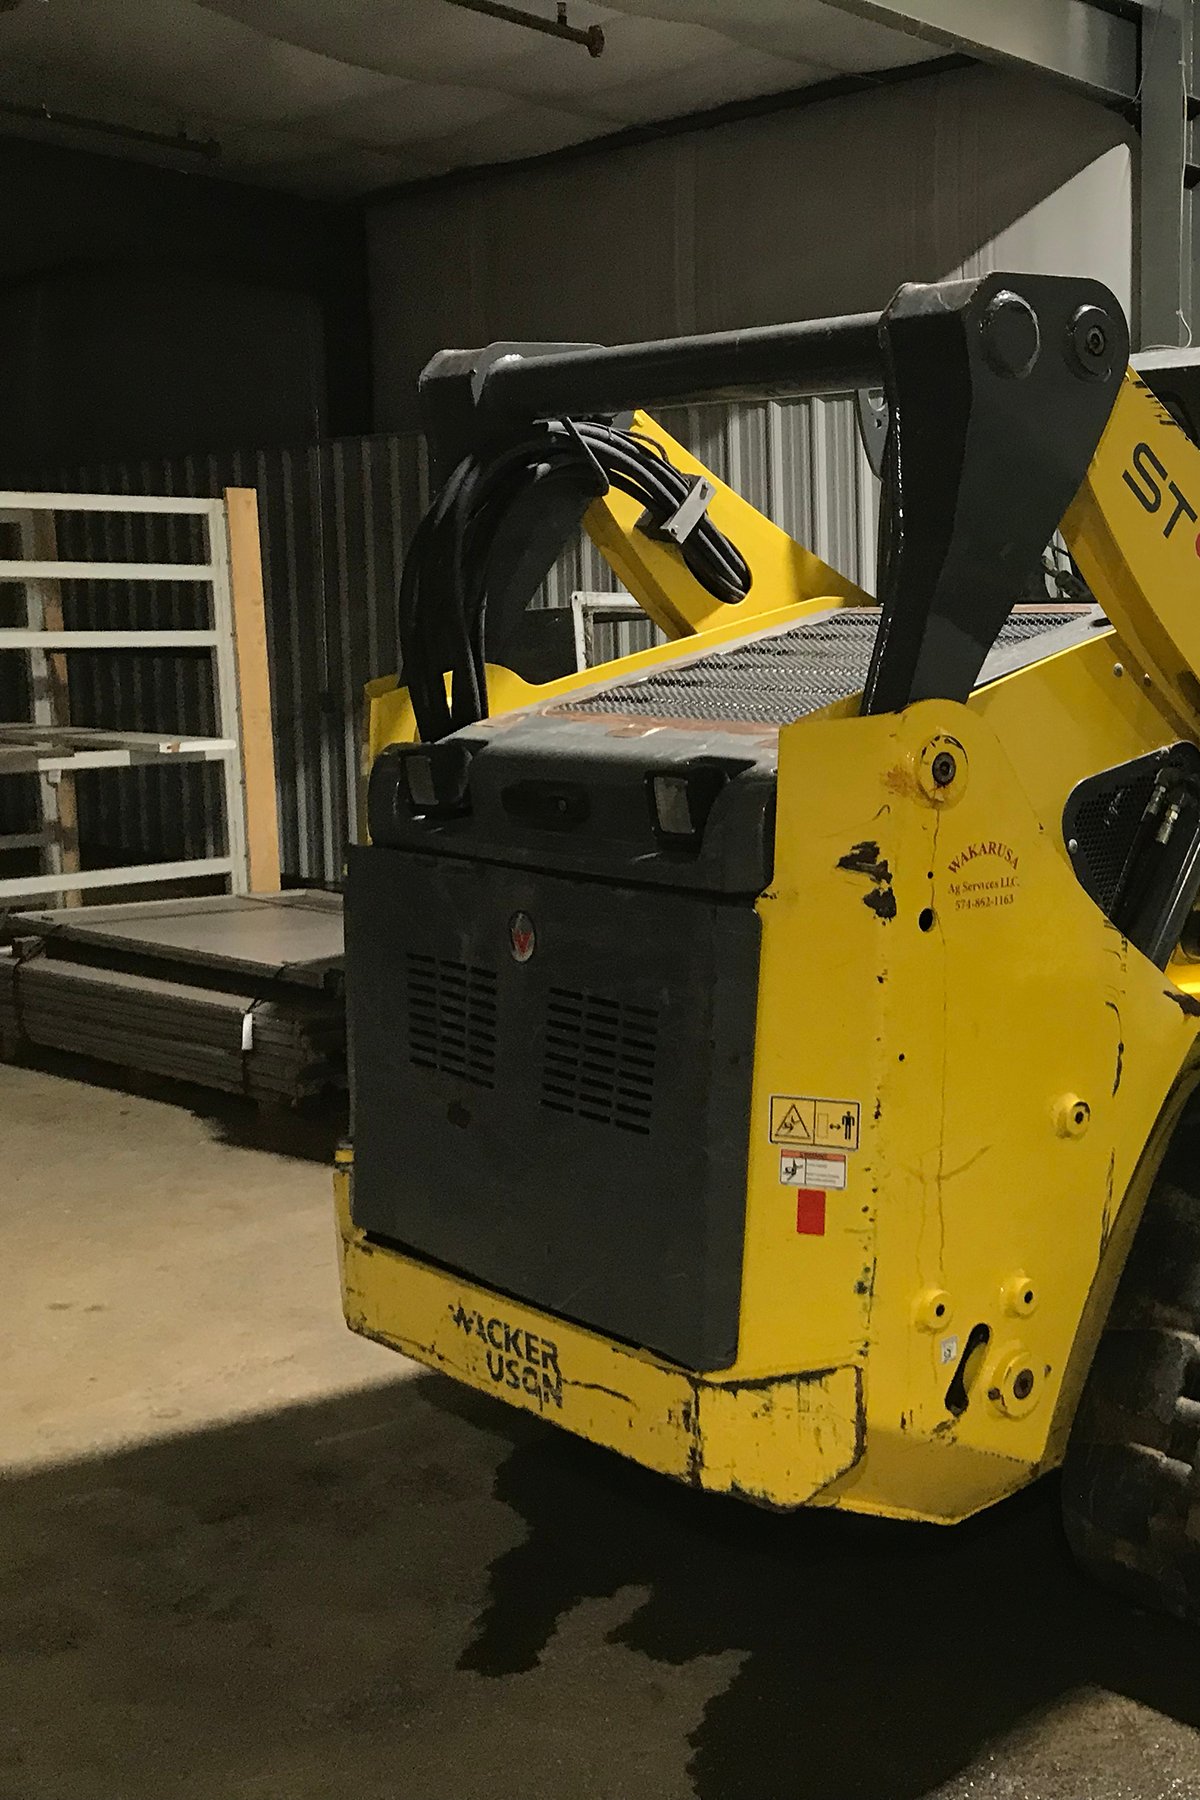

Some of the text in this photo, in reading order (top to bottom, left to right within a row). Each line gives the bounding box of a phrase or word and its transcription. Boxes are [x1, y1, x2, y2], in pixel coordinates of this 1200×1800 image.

[947, 841, 1019, 874] WAKARUSA
[948, 883, 961, 896] Ag
[962, 880, 999, 893] Services
